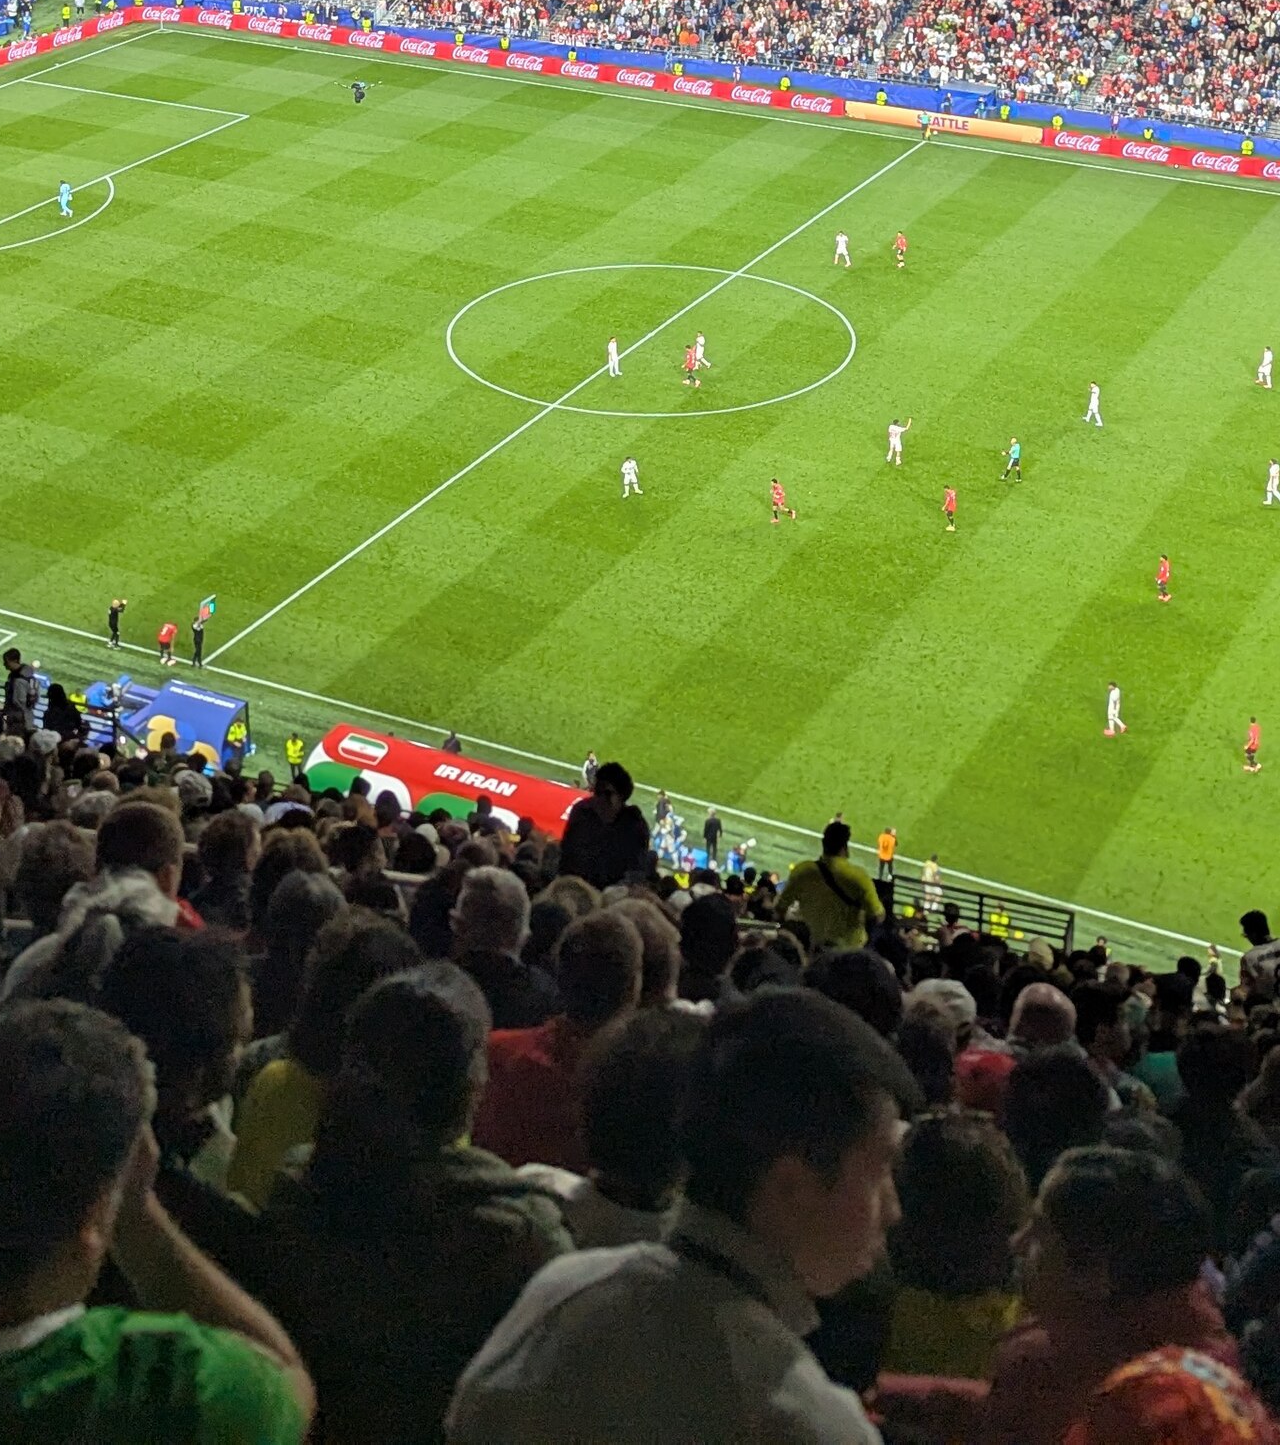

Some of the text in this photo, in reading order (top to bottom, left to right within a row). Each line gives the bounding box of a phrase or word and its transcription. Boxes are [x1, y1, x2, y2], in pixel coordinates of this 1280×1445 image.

[916, 114, 969, 131] SATTLE
[433, 763, 518, 798] IR IRAN
